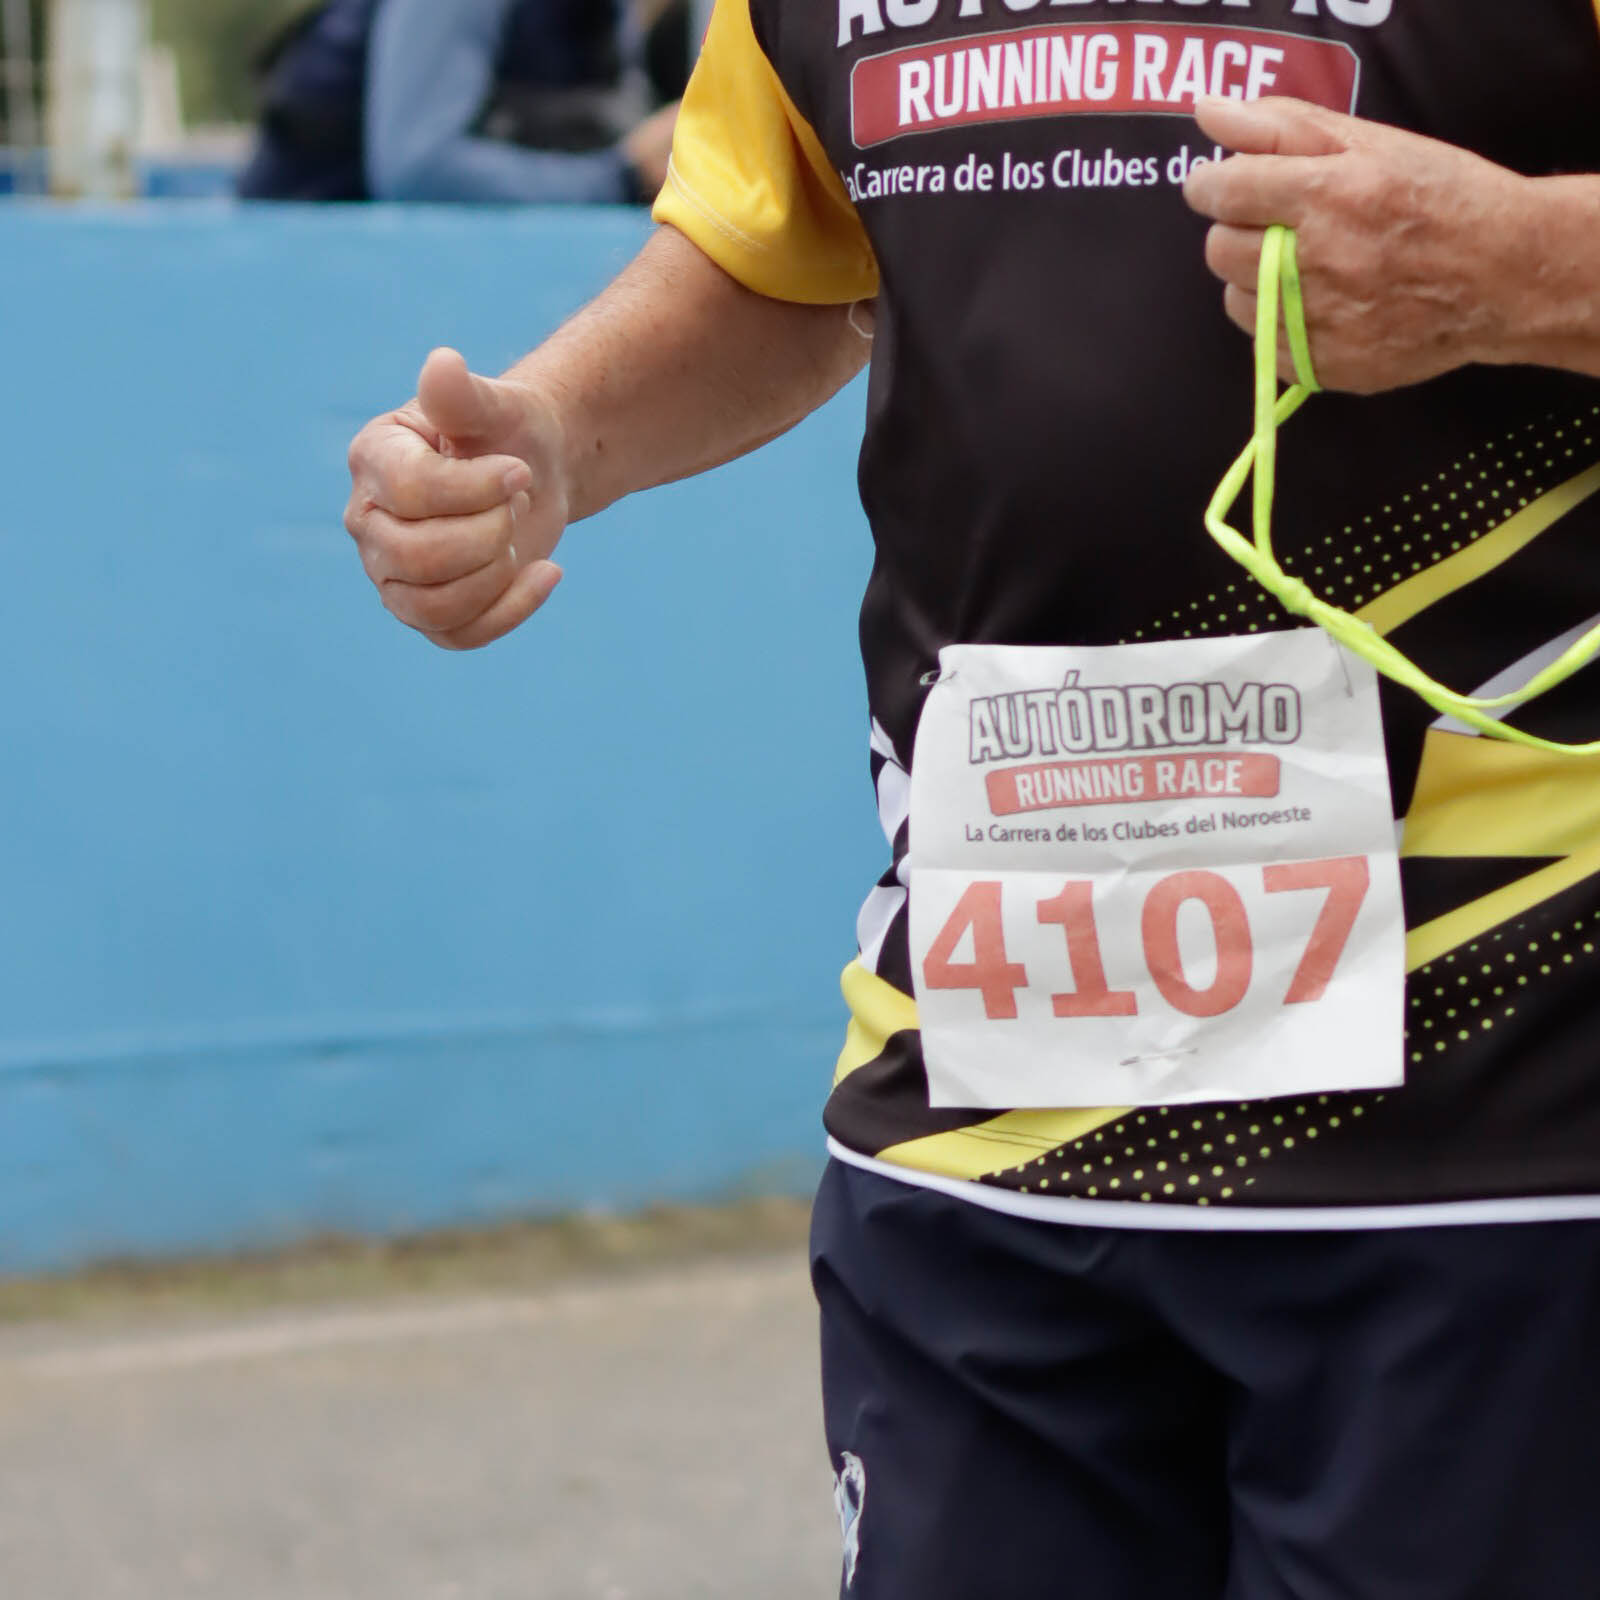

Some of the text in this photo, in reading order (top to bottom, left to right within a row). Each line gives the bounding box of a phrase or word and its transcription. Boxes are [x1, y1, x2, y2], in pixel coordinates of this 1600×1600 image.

[898, 34, 1284, 127] RUNNING RACE
[855, 163, 945, 199] Carrera
[954, 153, 994, 191] de
[1003, 152, 1044, 190] los
[1052, 148, 1157, 190] Clubes
[969, 669, 1302, 765] AUTÓDROMO
[1014, 759, 1242, 808] RUNNING RACE
[965, 805, 1312, 842] La Carrera de los Clubes del Noroeste
[922, 855, 1371, 1020] 4107
